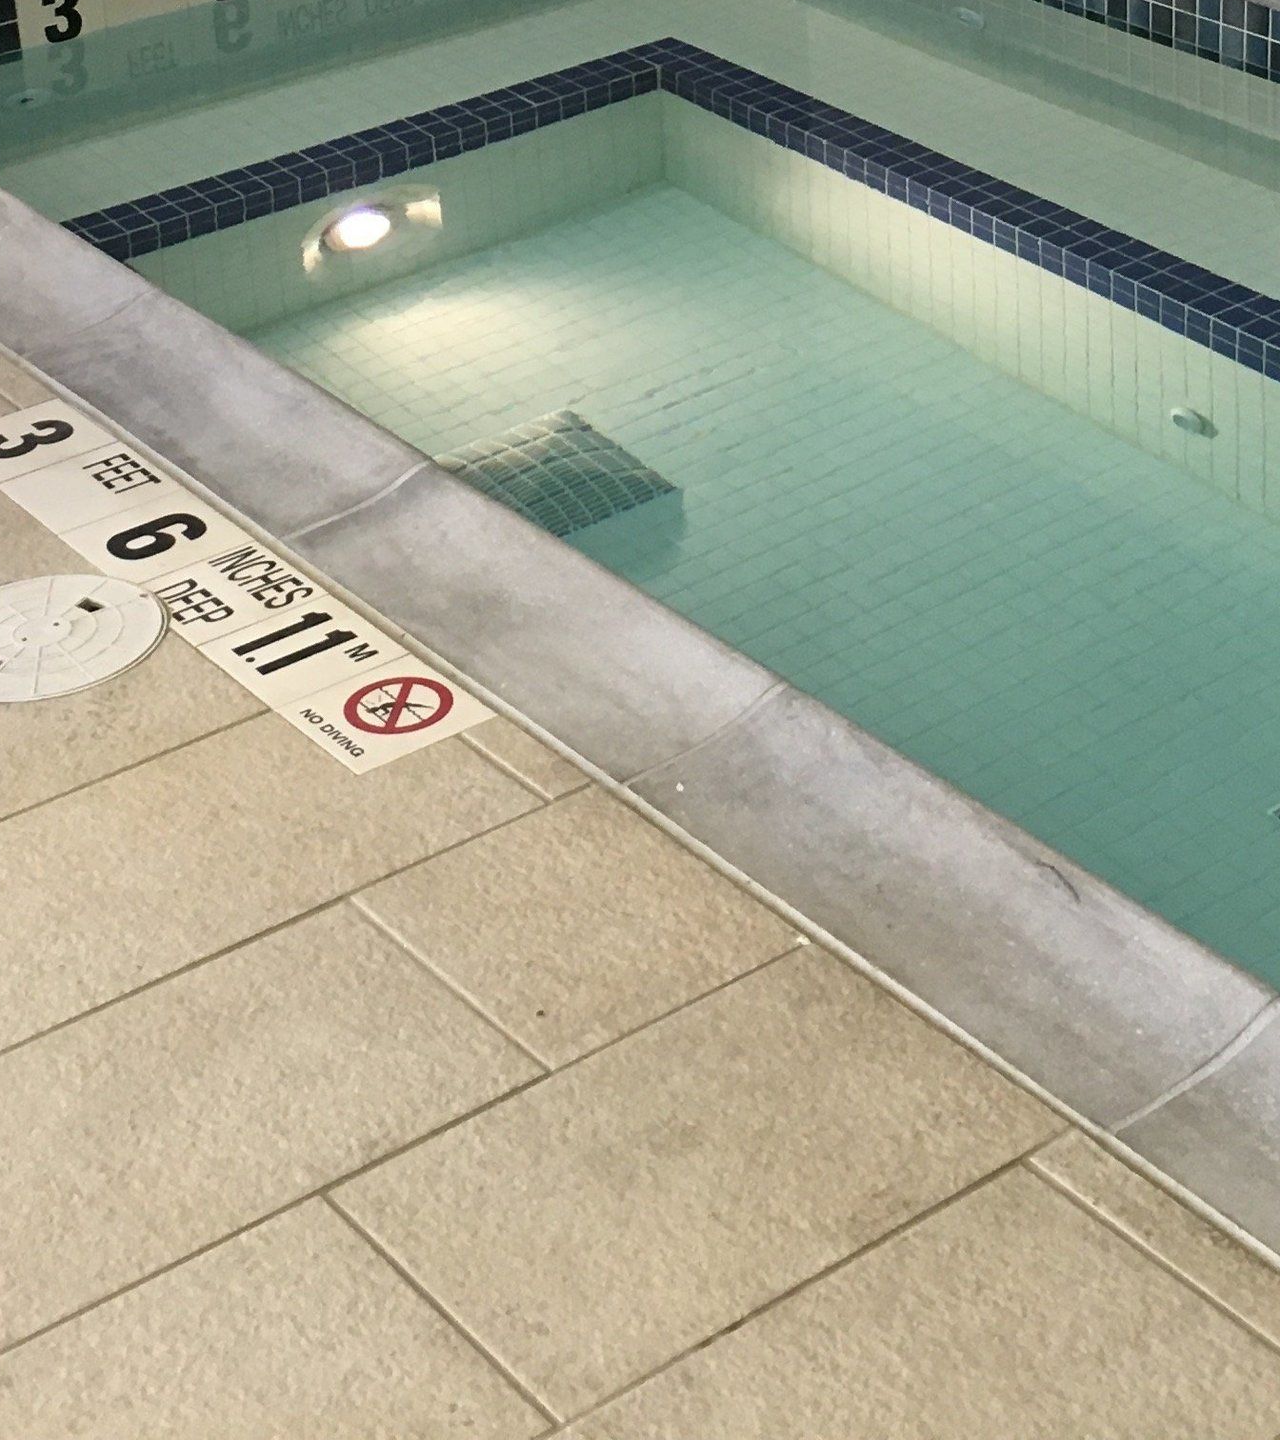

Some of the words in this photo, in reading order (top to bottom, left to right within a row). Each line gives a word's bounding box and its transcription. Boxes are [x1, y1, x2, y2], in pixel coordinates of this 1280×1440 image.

[82, 453, 162, 495] FEET
[106, 513, 207, 561] 6
[208, 545, 313, 610] INCHES
[158, 578, 235, 626] DEEP
[300, 708, 324, 724] NO
[320, 723, 365, 758] DIVING
